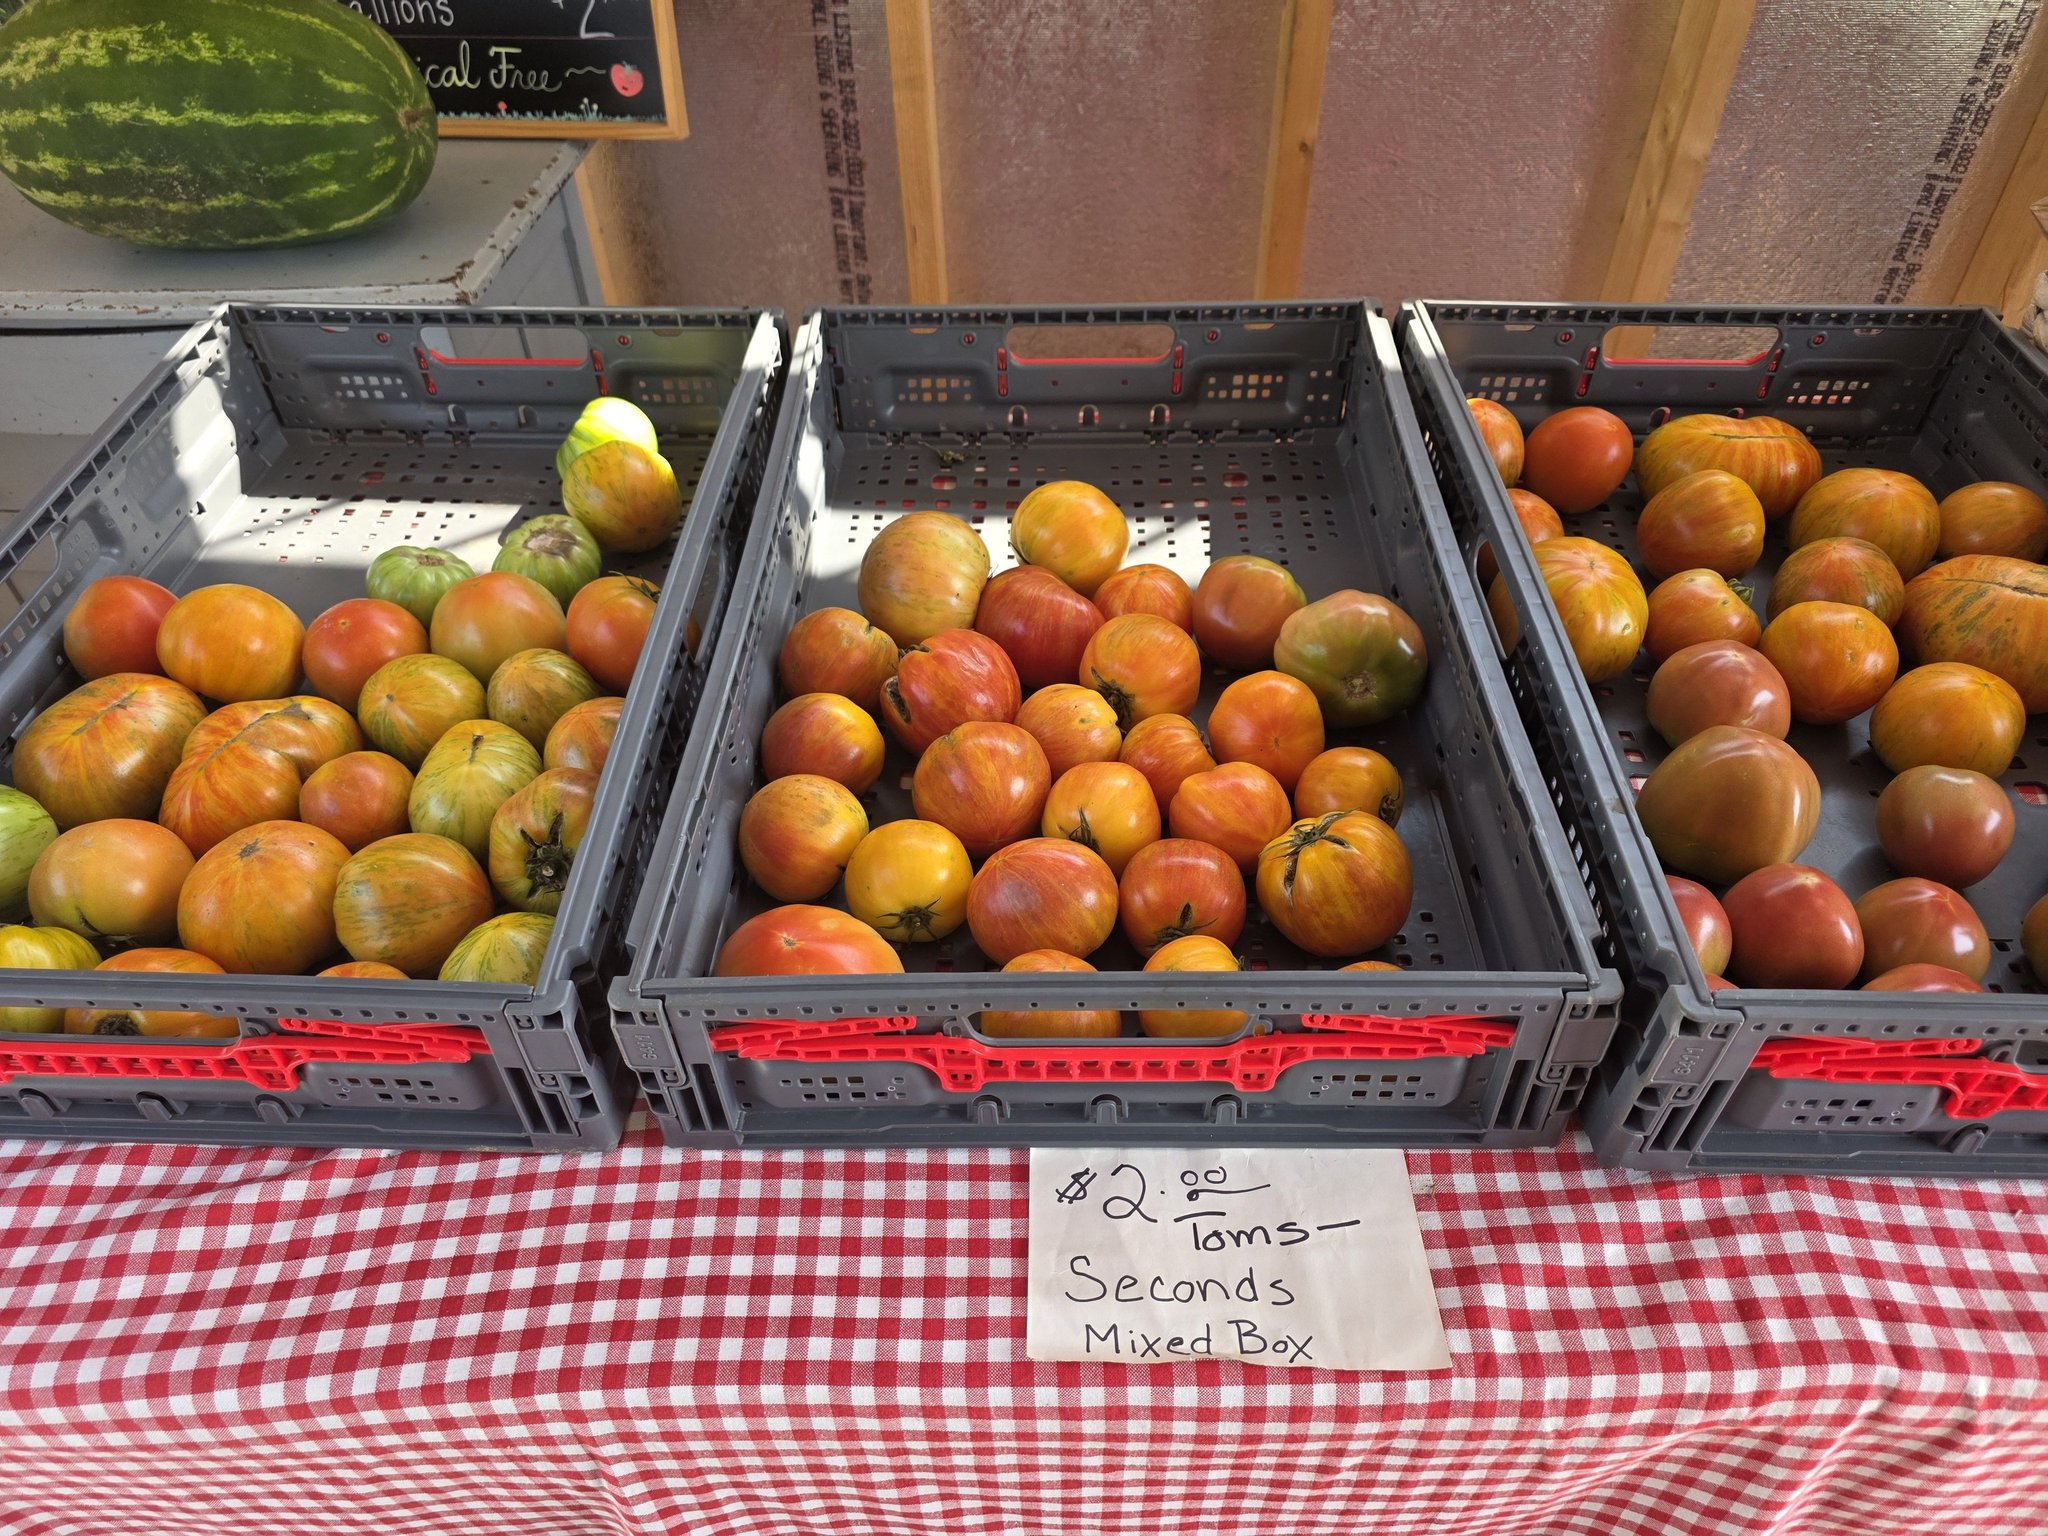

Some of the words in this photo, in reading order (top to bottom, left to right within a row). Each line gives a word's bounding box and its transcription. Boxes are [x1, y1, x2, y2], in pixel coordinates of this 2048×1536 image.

[488, 45, 562, 92] Free
[1065, 1255, 1295, 1306] Seconds
[1085, 1322, 1213, 1358] Mixed
[1226, 1319, 1314, 1364] Box
